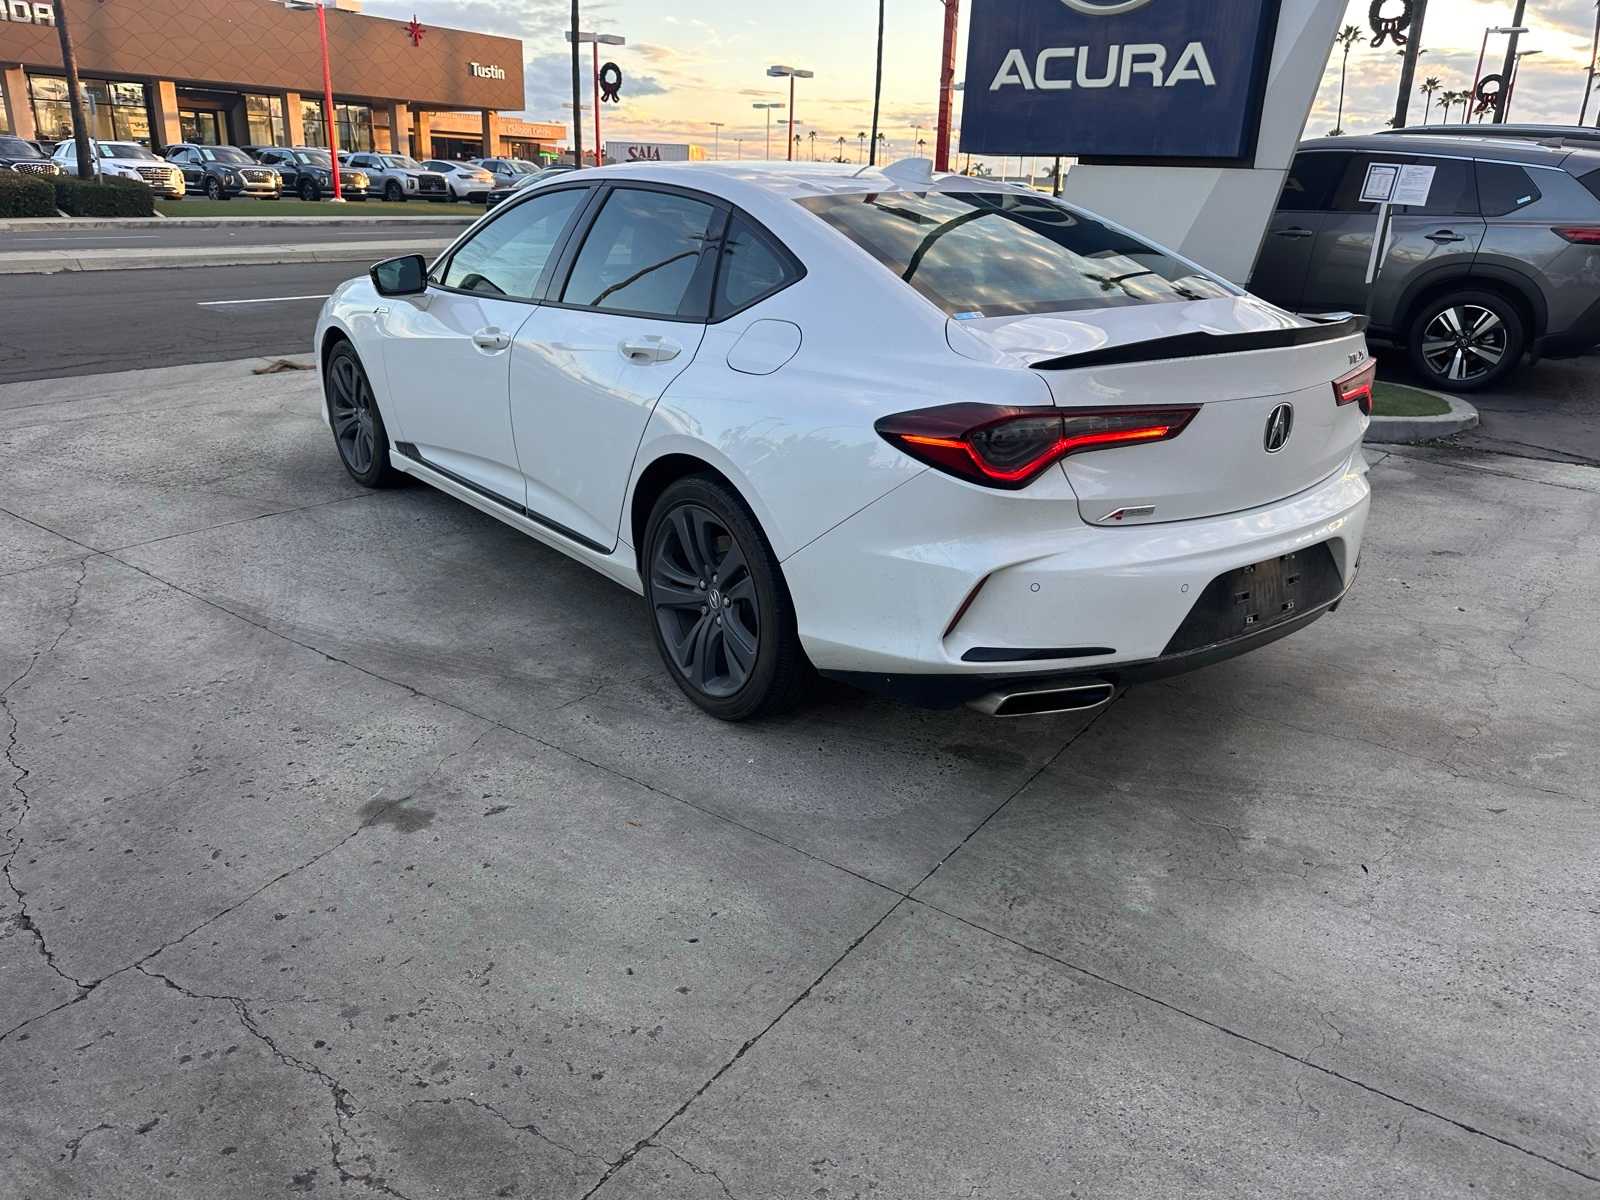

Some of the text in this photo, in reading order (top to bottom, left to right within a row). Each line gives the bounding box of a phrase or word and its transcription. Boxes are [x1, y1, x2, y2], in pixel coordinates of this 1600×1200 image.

[470, 62, 505, 80] Tustin
[989, 41, 1216, 90] ACURA
[627, 146, 660, 161] SAIA
